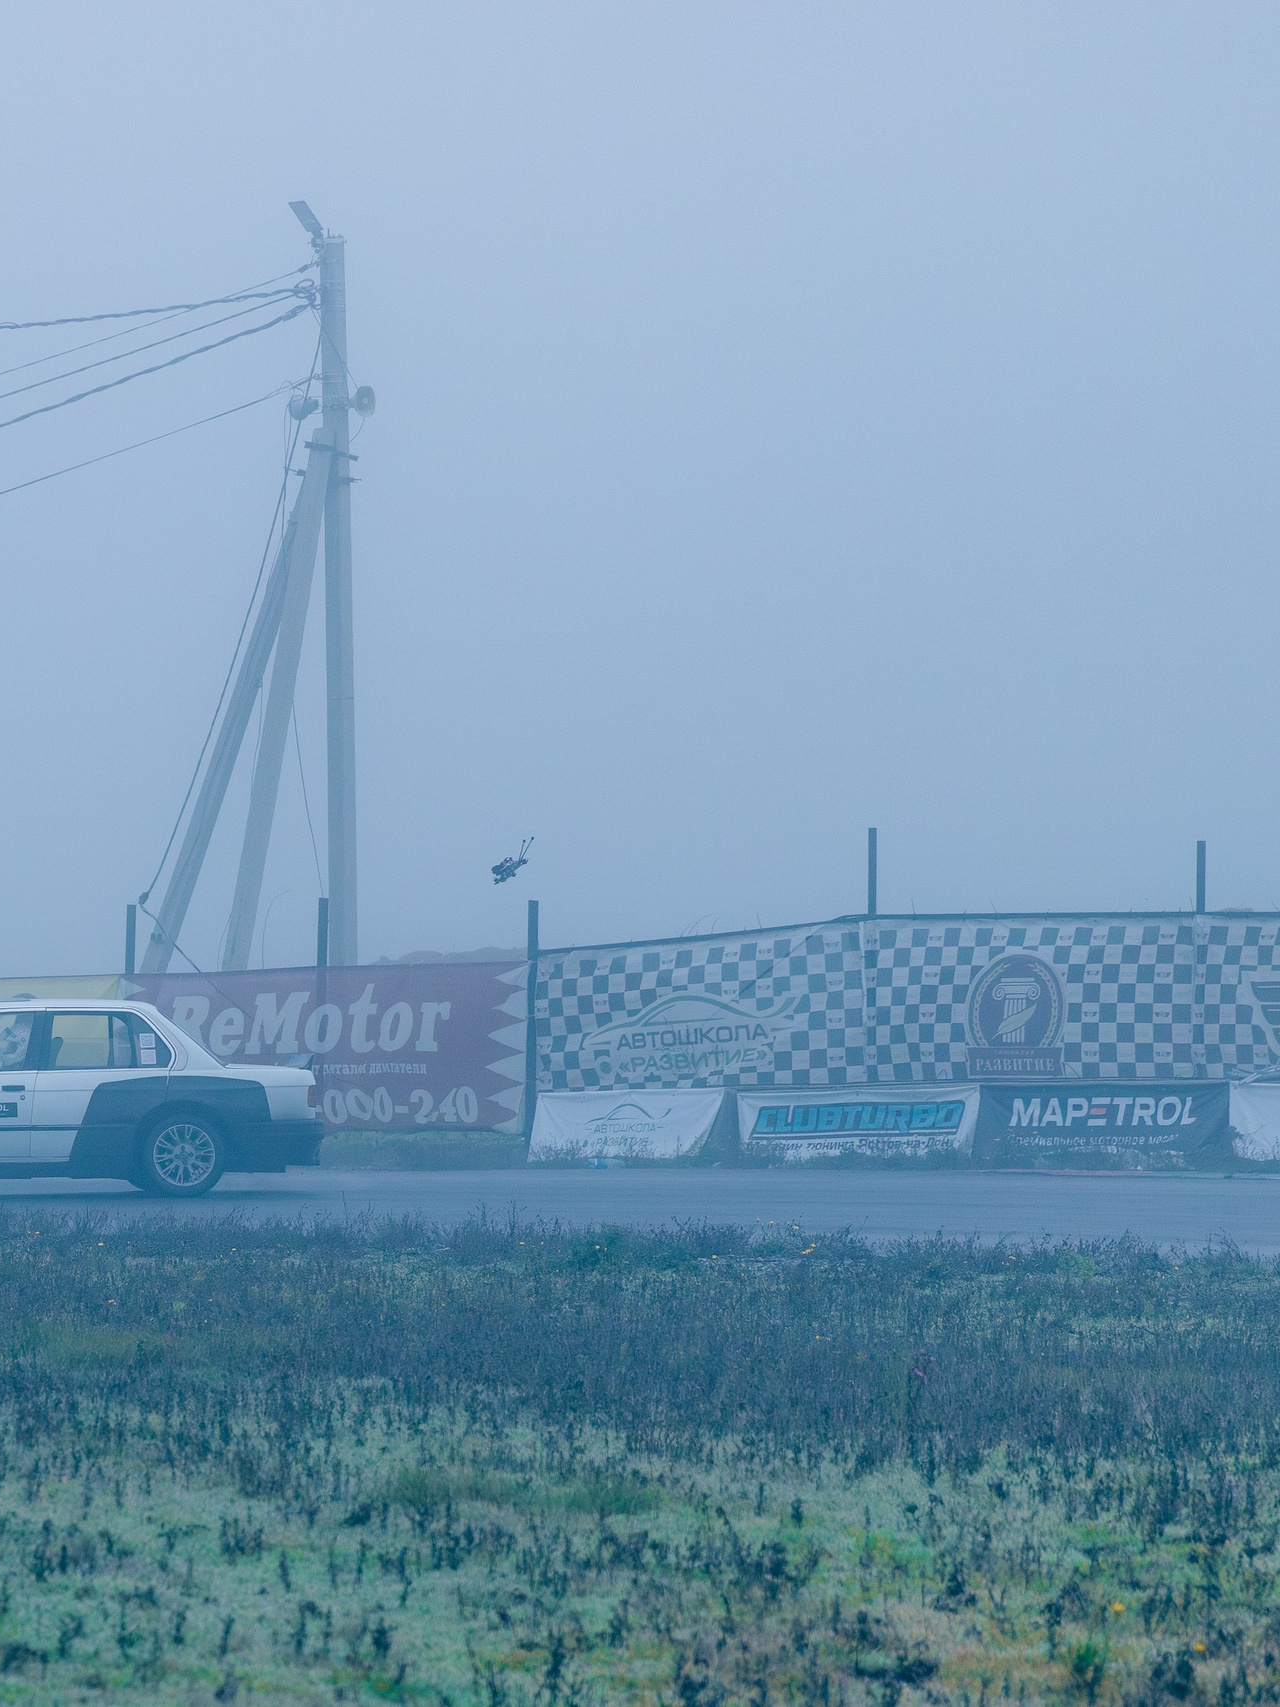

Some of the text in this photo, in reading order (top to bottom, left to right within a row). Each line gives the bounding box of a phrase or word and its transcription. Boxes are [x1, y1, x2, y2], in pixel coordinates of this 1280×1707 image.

[171, 983, 452, 1057] ReMotor
[616, 1023, 769, 1051] АВТОШКОЛА
[368, 1061, 428, 1077] двигателя
[975, 1057, 1056, 1072] РАЗВИТИЕ
[756, 1102, 964, 1133] CLUBTURBO
[1009, 1096, 1198, 1127] MAPETROL
[594, 1123, 656, 1134] АВТОШКОЛА
